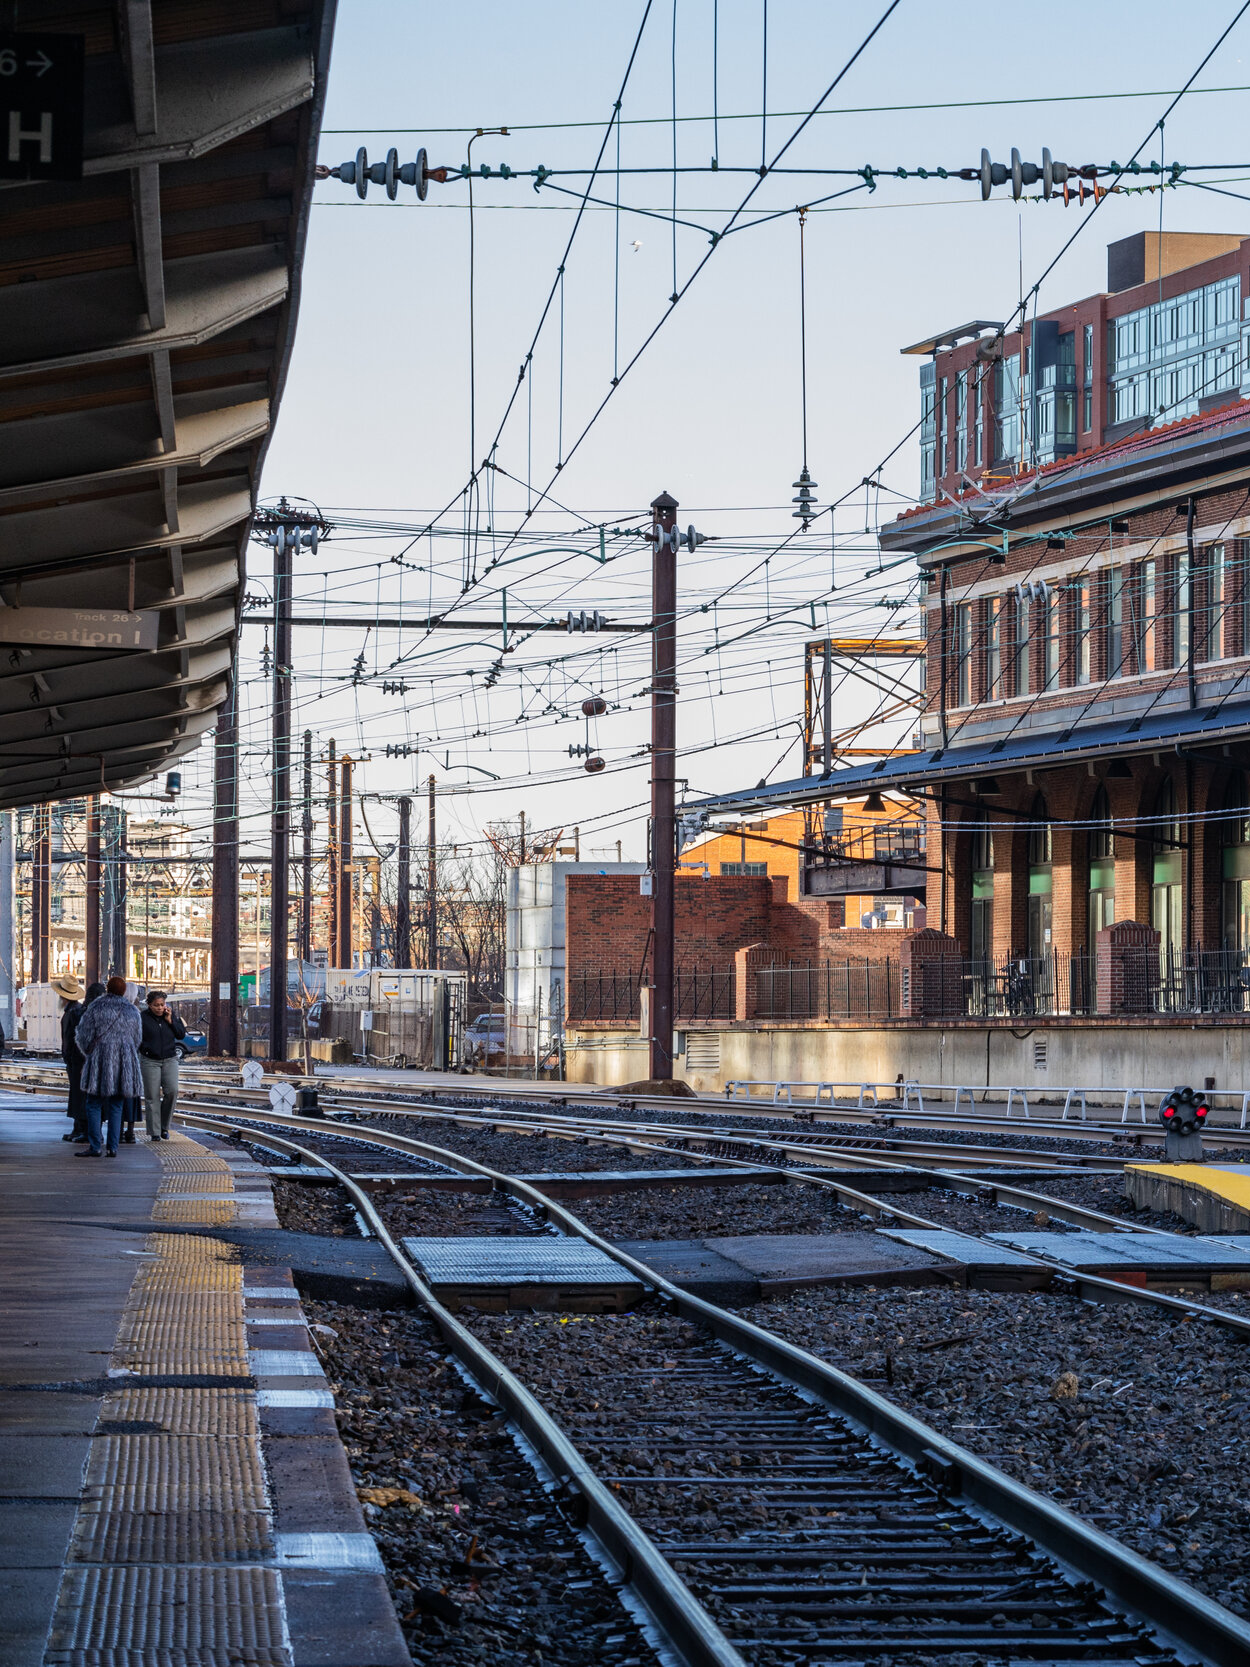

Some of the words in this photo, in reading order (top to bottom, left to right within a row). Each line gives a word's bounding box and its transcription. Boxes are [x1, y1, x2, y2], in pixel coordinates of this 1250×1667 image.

[8, 110, 53, 163] H
[73, 612, 107, 622] Track
[112, 613, 129, 623] 26
[2, 625, 122, 644] Location
